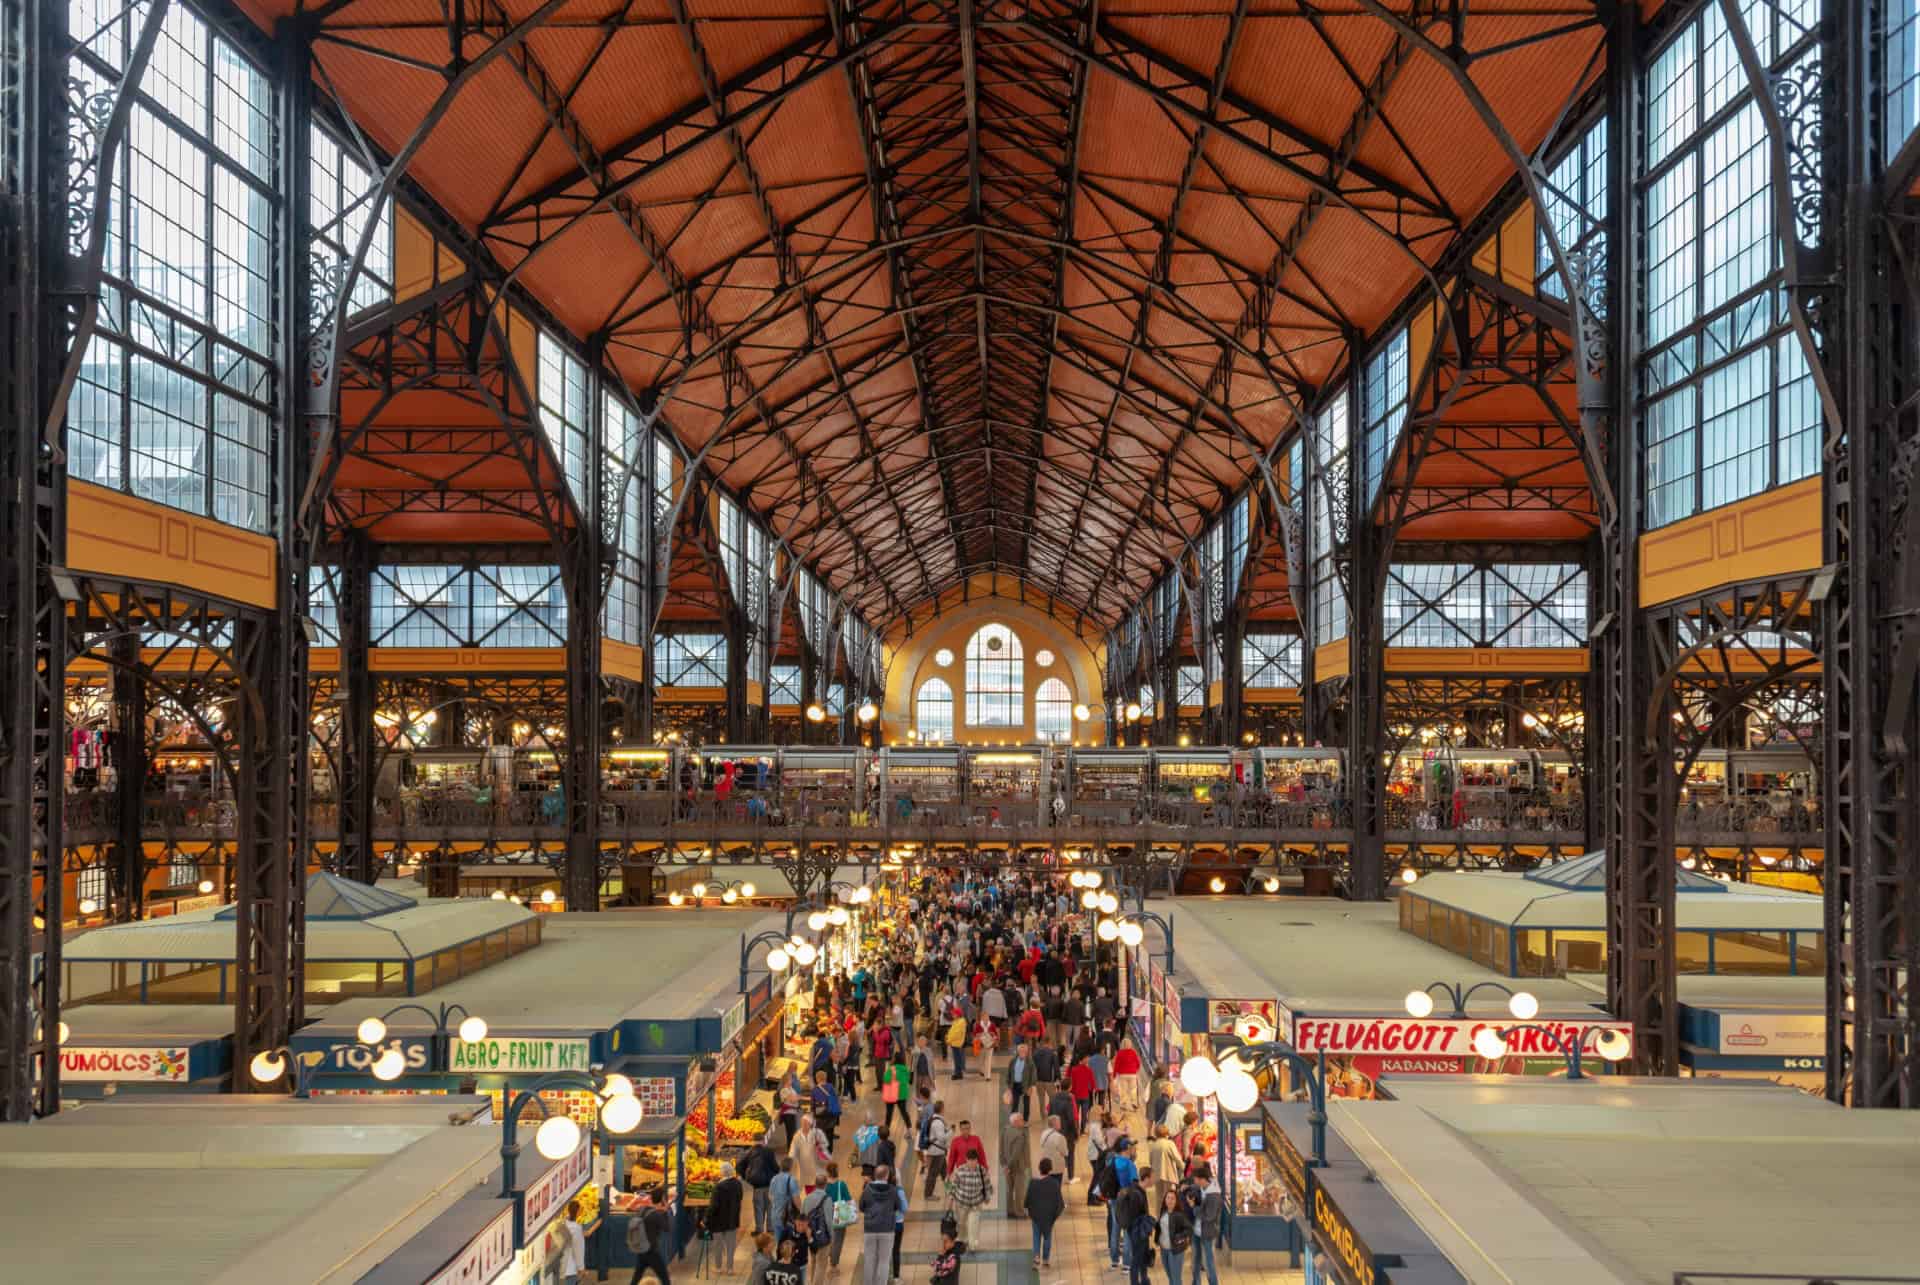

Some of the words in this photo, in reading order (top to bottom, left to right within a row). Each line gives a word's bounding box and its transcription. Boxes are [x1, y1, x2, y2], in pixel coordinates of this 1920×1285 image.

[1299, 1018, 1458, 1051] FELVÁGOTT
[455, 1041, 554, 1068] AGRO-FRUIT
[1381, 1060, 1459, 1073] KABANOS
